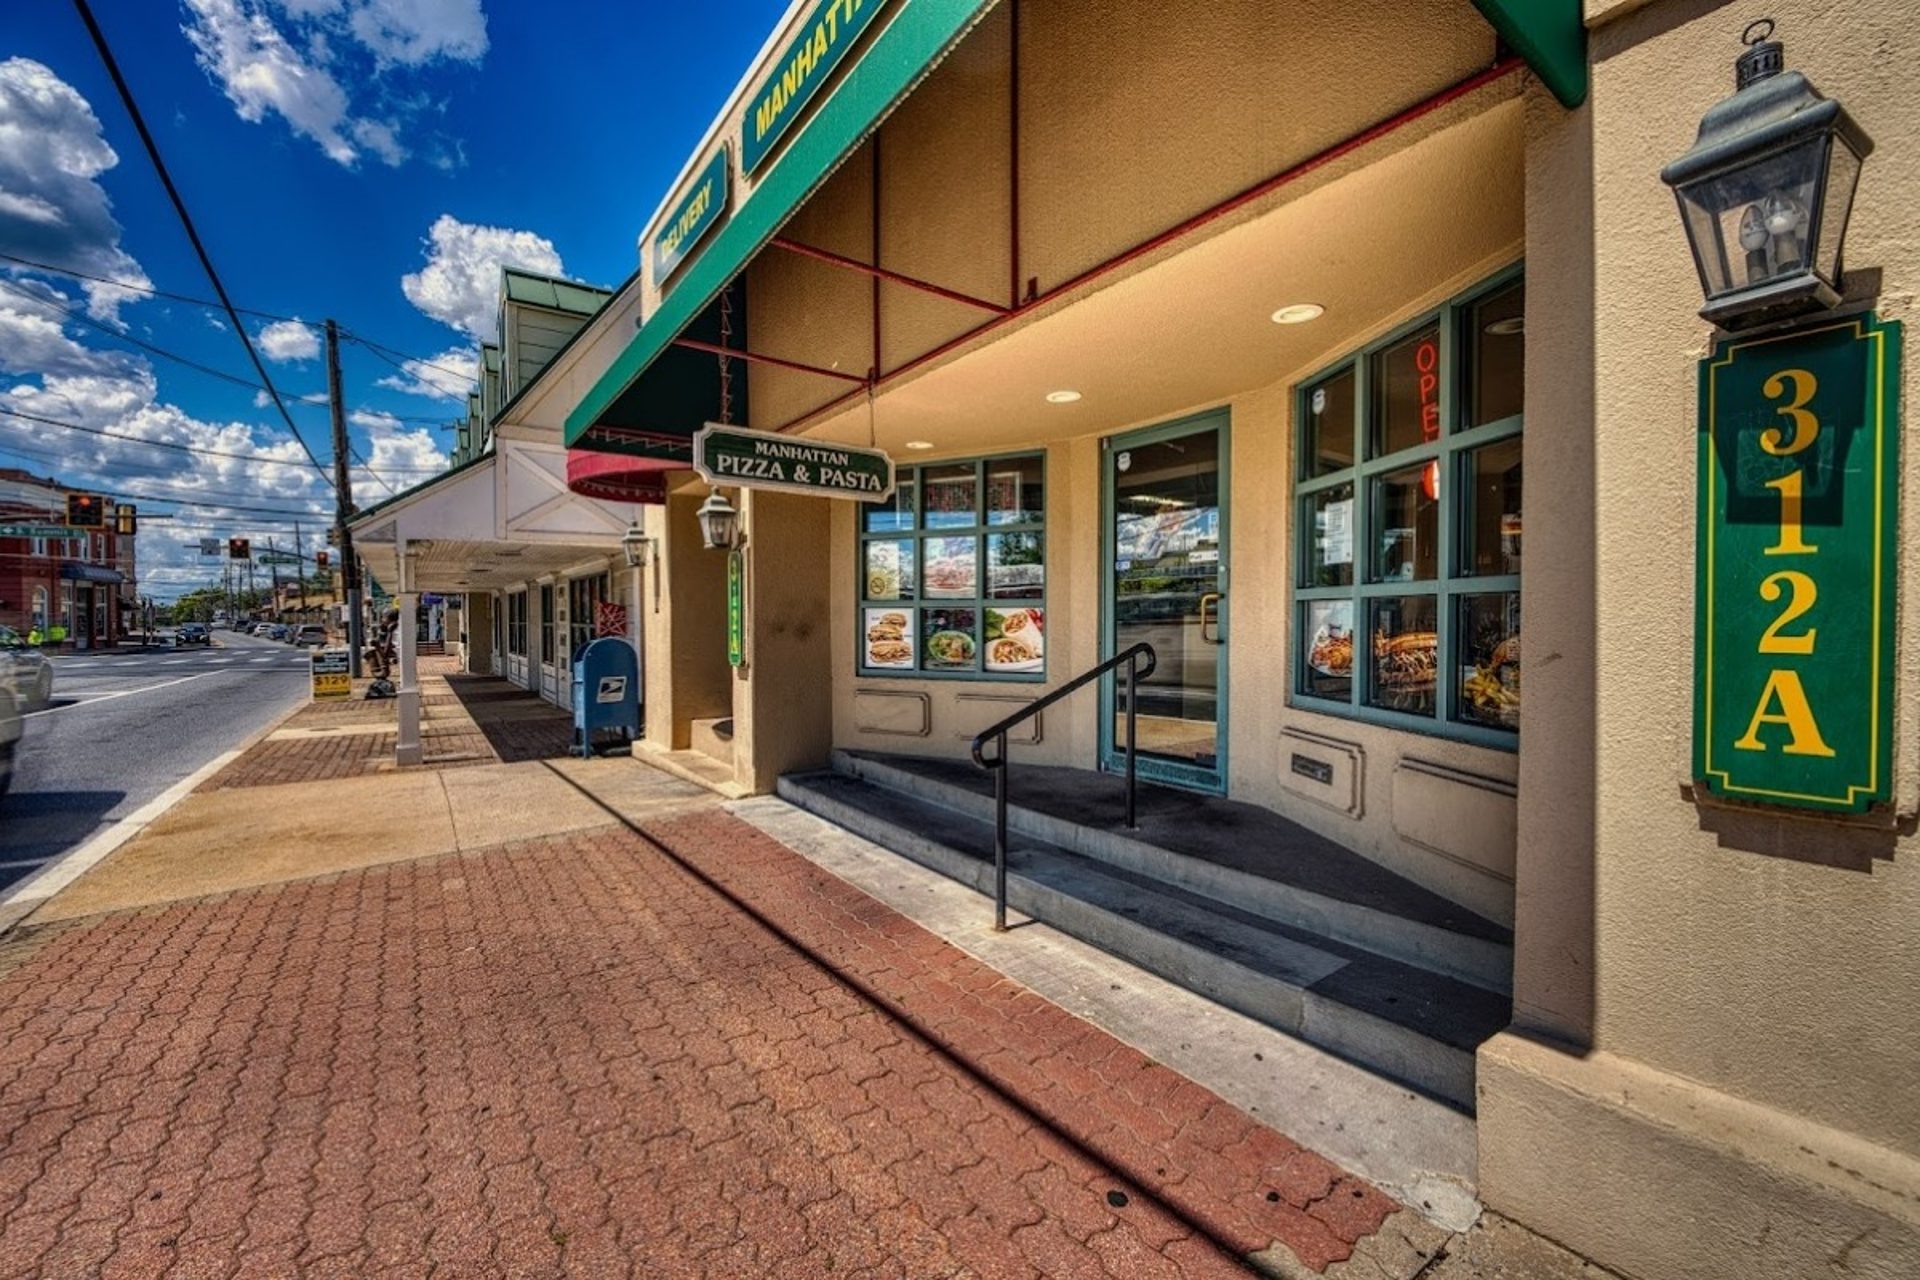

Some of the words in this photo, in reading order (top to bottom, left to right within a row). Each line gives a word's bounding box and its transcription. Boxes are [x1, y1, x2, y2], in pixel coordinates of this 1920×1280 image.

[756, 0, 863, 142] MANHATT
[662, 178, 712, 264] DELIVERY
[1416, 343, 1441, 443] OPE
[716, 454, 785, 479] PIZZA
[793, 464, 810, 483] &
[820, 467, 882, 491] PASTA
[755, 441, 849, 466] MANHATTAN
[1734, 368, 1836, 758] 312A
